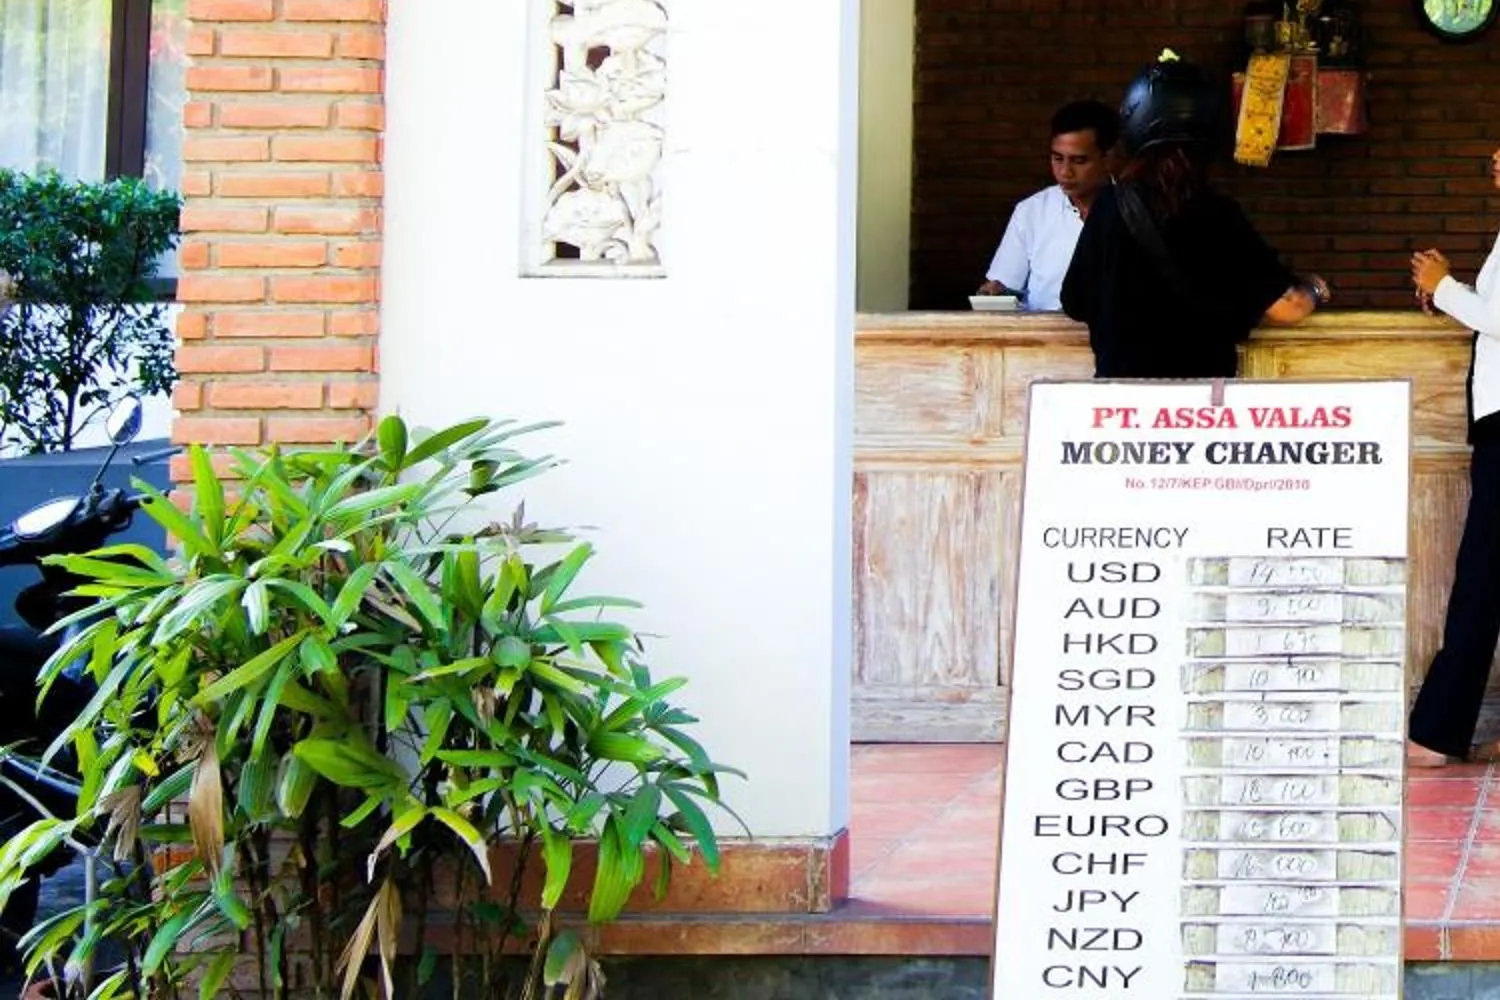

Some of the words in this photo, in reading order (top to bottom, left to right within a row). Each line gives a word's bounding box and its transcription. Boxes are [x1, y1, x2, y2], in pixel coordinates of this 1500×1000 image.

[1091, 407, 1141, 429] PT.
[1151, 406, 1238, 429] ASSA
[1247, 406, 1353, 429] VALAS
[1060, 441, 1196, 465] MONEY
[1204, 440, 1383, 466] CHANGER
[1042, 526, 1190, 549] CURRENCY
[1265, 527, 1354, 549] RATE
[1067, 561, 1162, 585] USD
[1063, 597, 1161, 620] AUD
[1062, 632, 1159, 656] HKD
[1056, 668, 1156, 691] SGD
[1055, 703, 1156, 728] MYR
[1056, 740, 1154, 765] CAD
[1055, 777, 1154, 802] GBP
[1033, 814, 1170, 838] EURO
[1051, 851, 1149, 876] CHF
[1051, 889, 1141, 914] JPY
[1046, 926, 1144, 951] NZD
[1041, 963, 1143, 990] CNY
